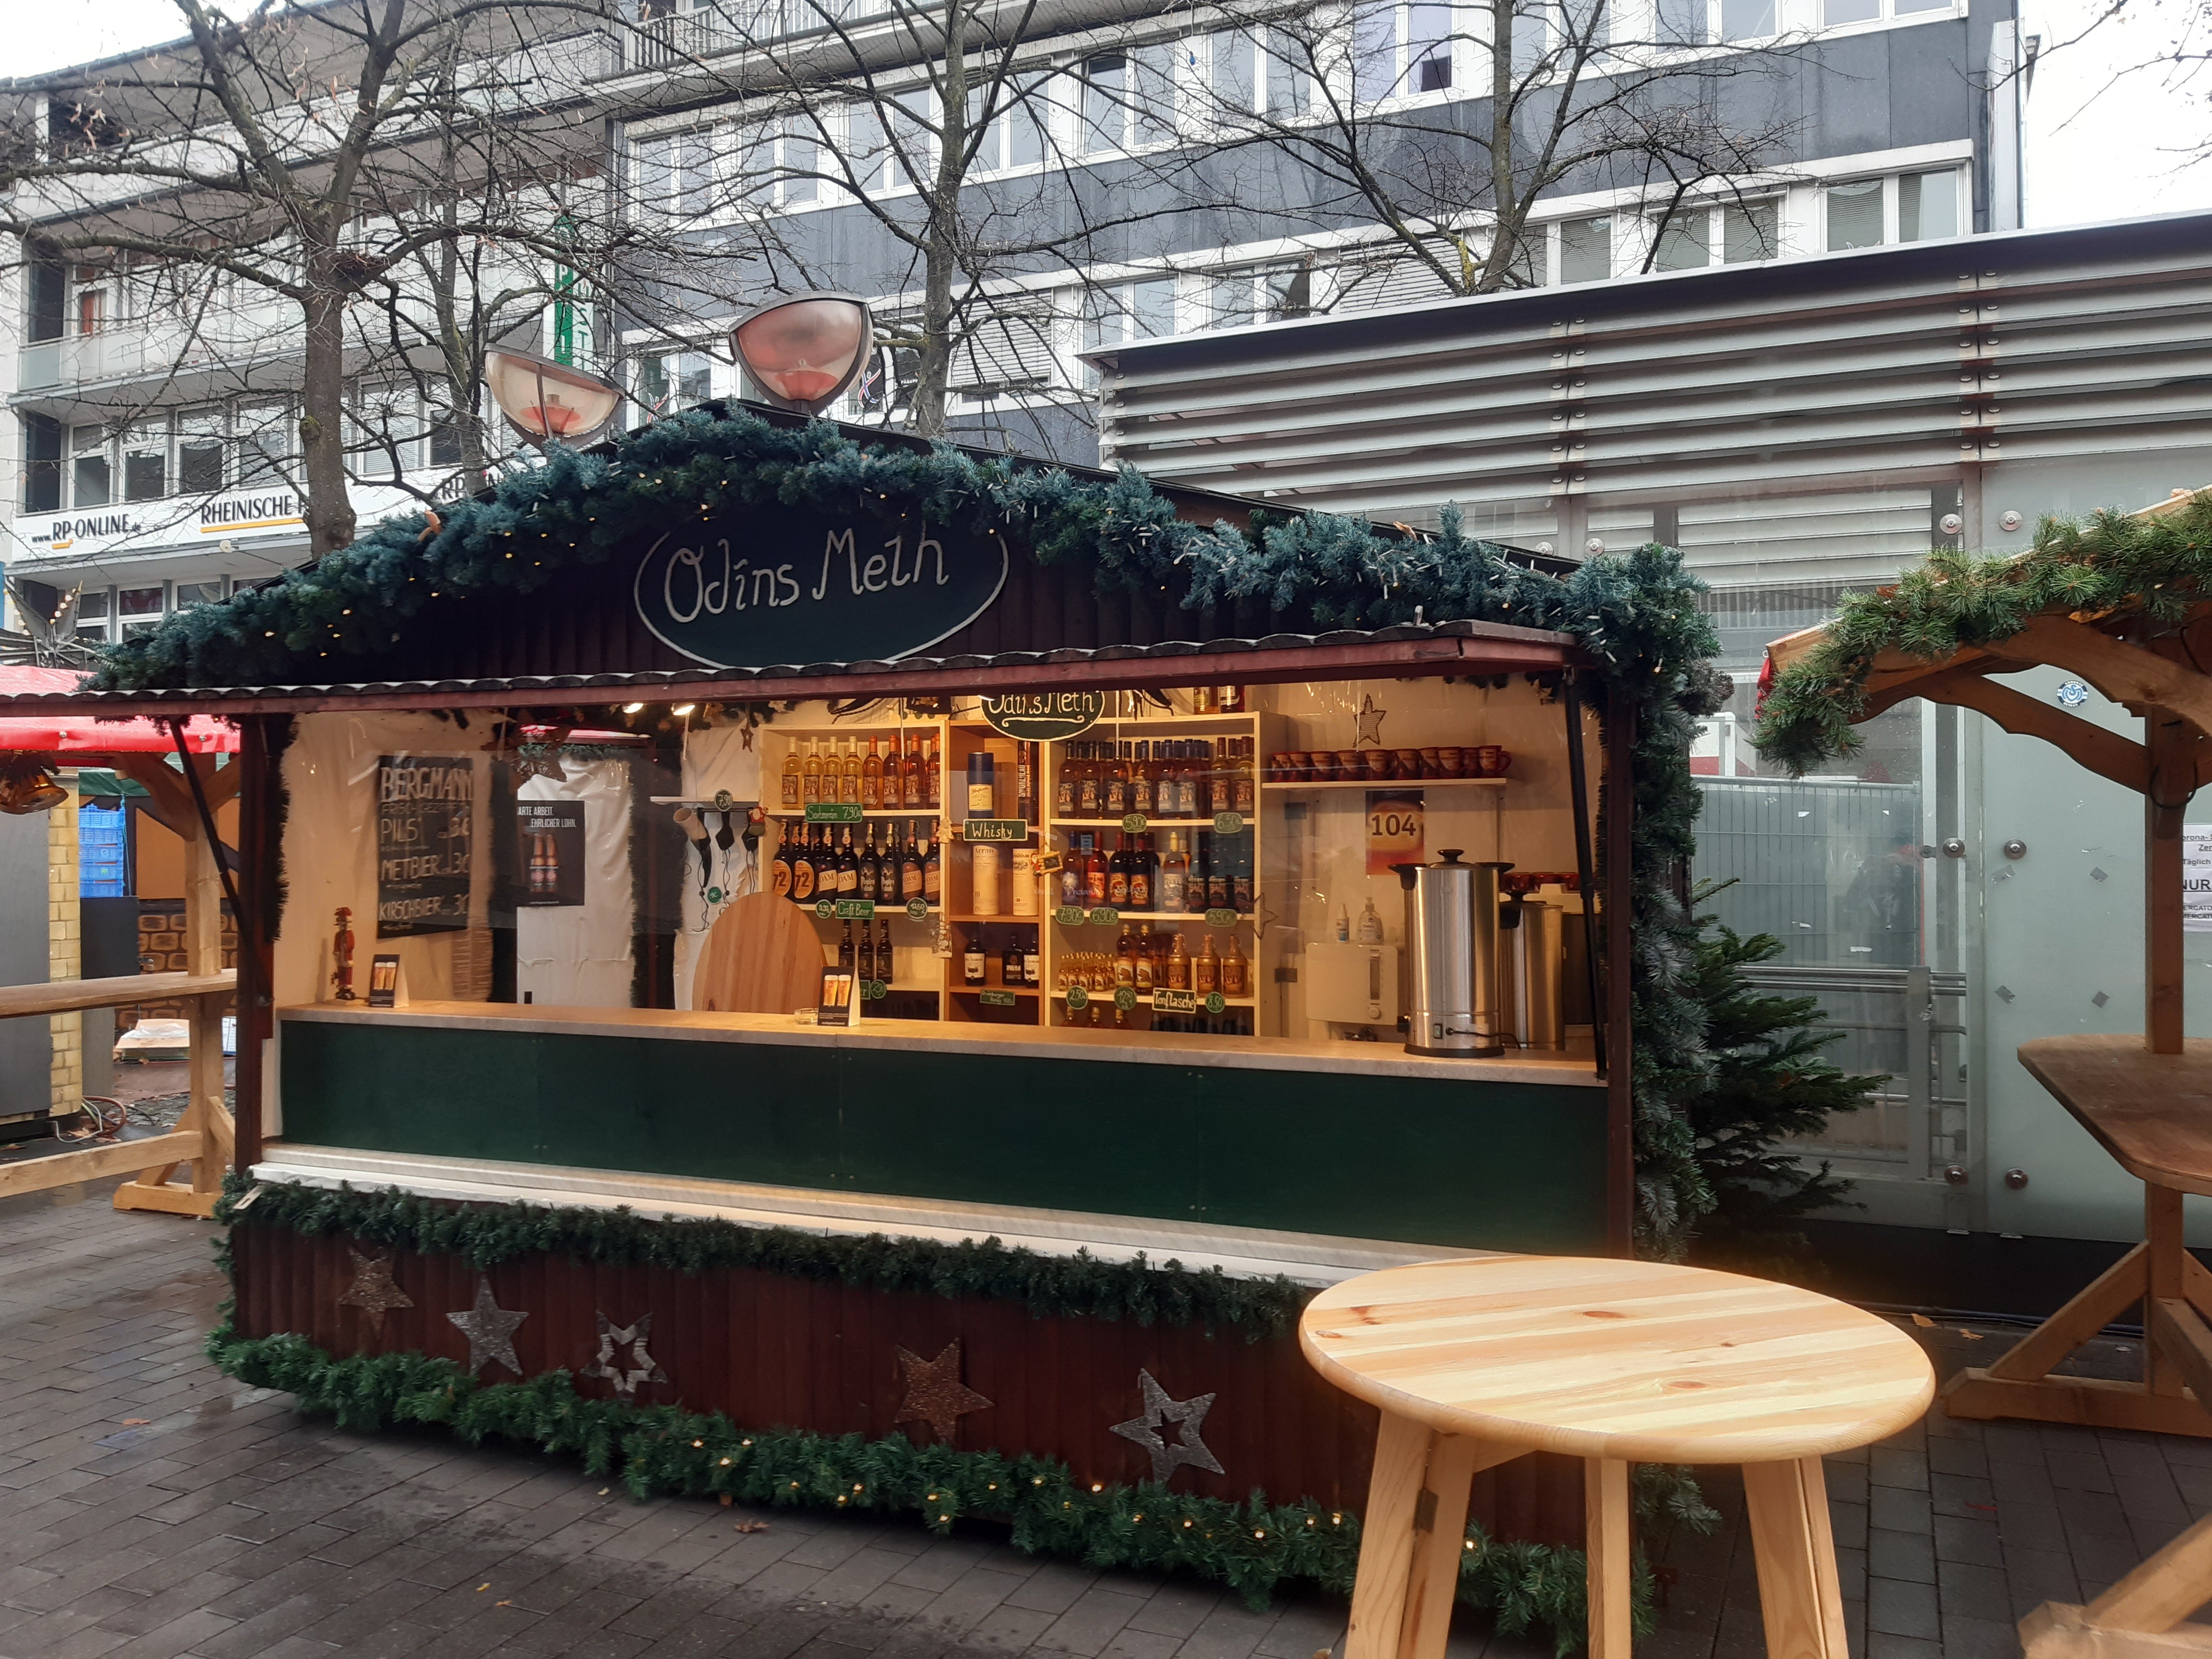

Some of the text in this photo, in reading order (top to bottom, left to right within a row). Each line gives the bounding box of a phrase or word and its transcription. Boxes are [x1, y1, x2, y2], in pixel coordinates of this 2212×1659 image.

[200, 495, 292, 525] RHEINISCHE
[664, 538, 800, 623] Odins
[517, 806, 532, 816] ARTE
[531, 818, 577, 828] EHRLICHER LOHN.
[972, 822, 1012, 839] Whisky
[1371, 814, 1416, 836] 104
[838, 902, 871, 916] Craft Beer
[1154, 991, 1194, 1009] Tonflasche
